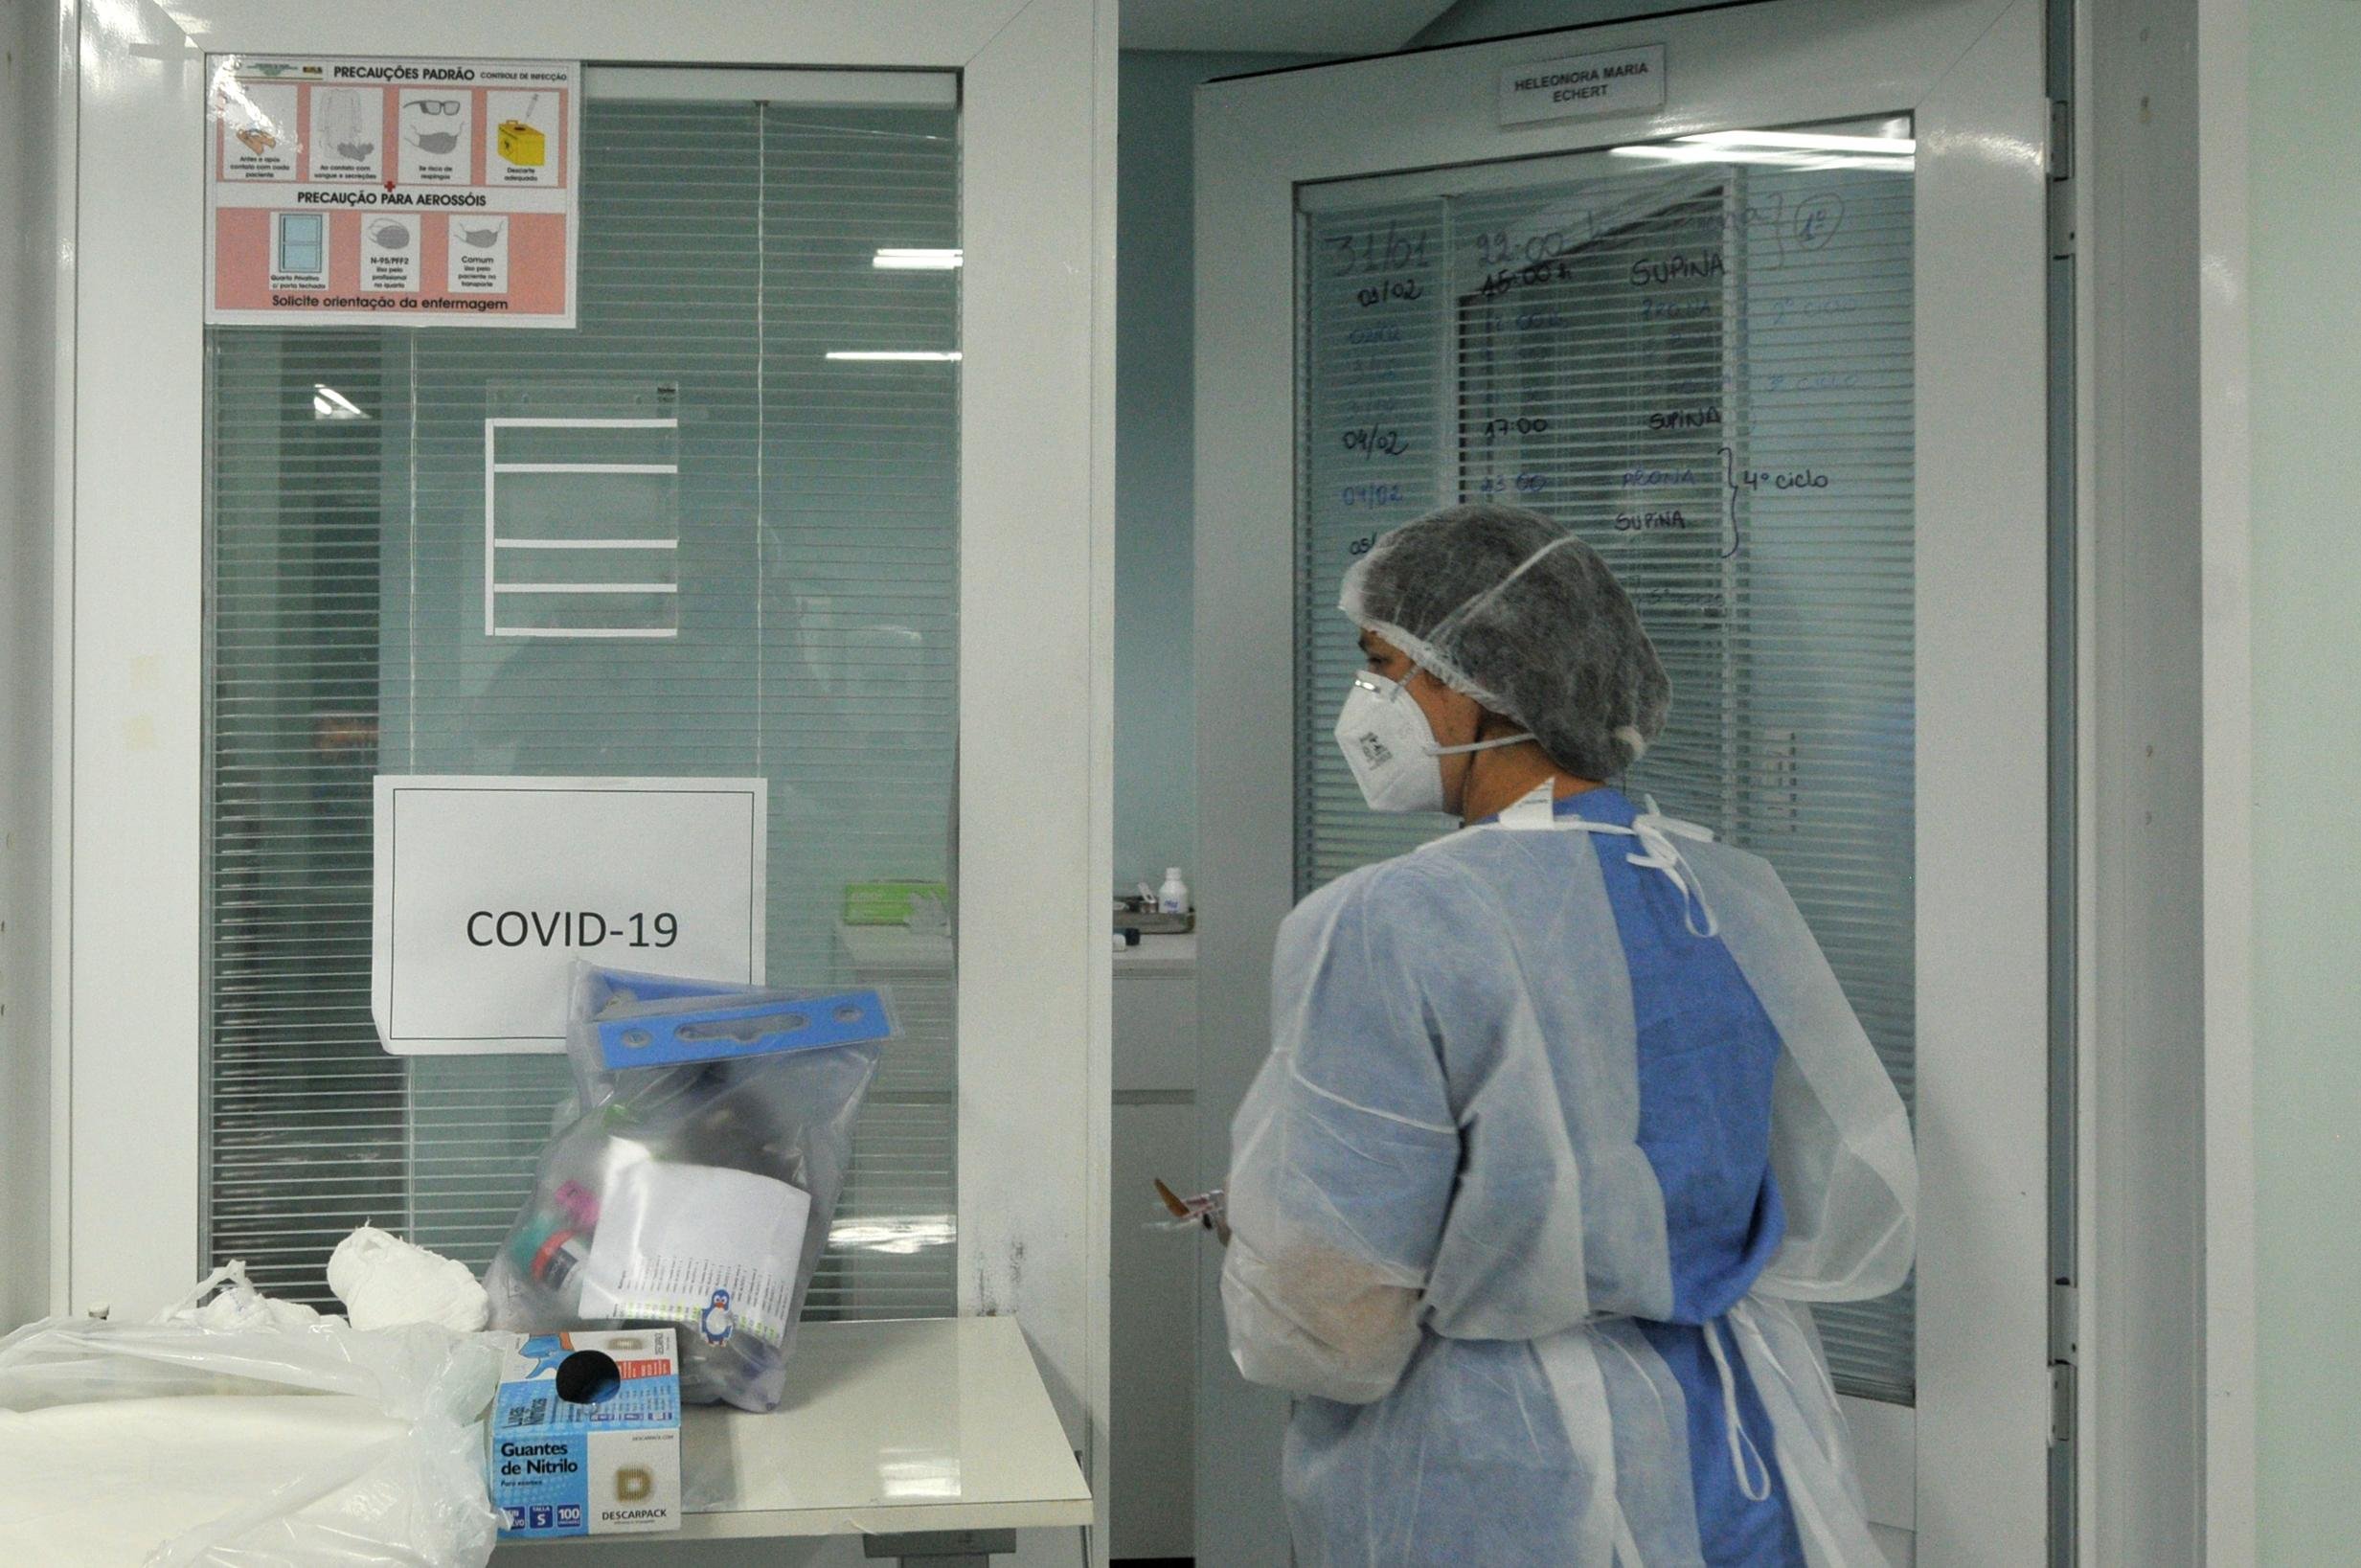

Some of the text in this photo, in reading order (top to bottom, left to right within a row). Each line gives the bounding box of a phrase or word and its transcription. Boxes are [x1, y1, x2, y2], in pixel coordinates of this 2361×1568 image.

[334, 65, 419, 81] PRECAUÇÕES
[422, 66, 475, 80] PADRÃO
[1514, 62, 1648, 91] HELEONORA MARIA
[1553, 84, 1609, 103] ECHERT
[298, 191, 487, 206] PRECAUÇÃO PARA AEROSSÓIS
[272, 295, 509, 311] Solicite orientação da enfermagem
[1776, 468, 1829, 489] ciclo
[466, 910, 679, 948] COVID-19
[501, 1442, 568, 1457] Guantes
[501, 1458, 579, 1475] de Nitrilo
[536, 1513, 547, 1526] S
[557, 1508, 580, 1520] 100
[602, 1509, 667, 1521] DESCARPACK
